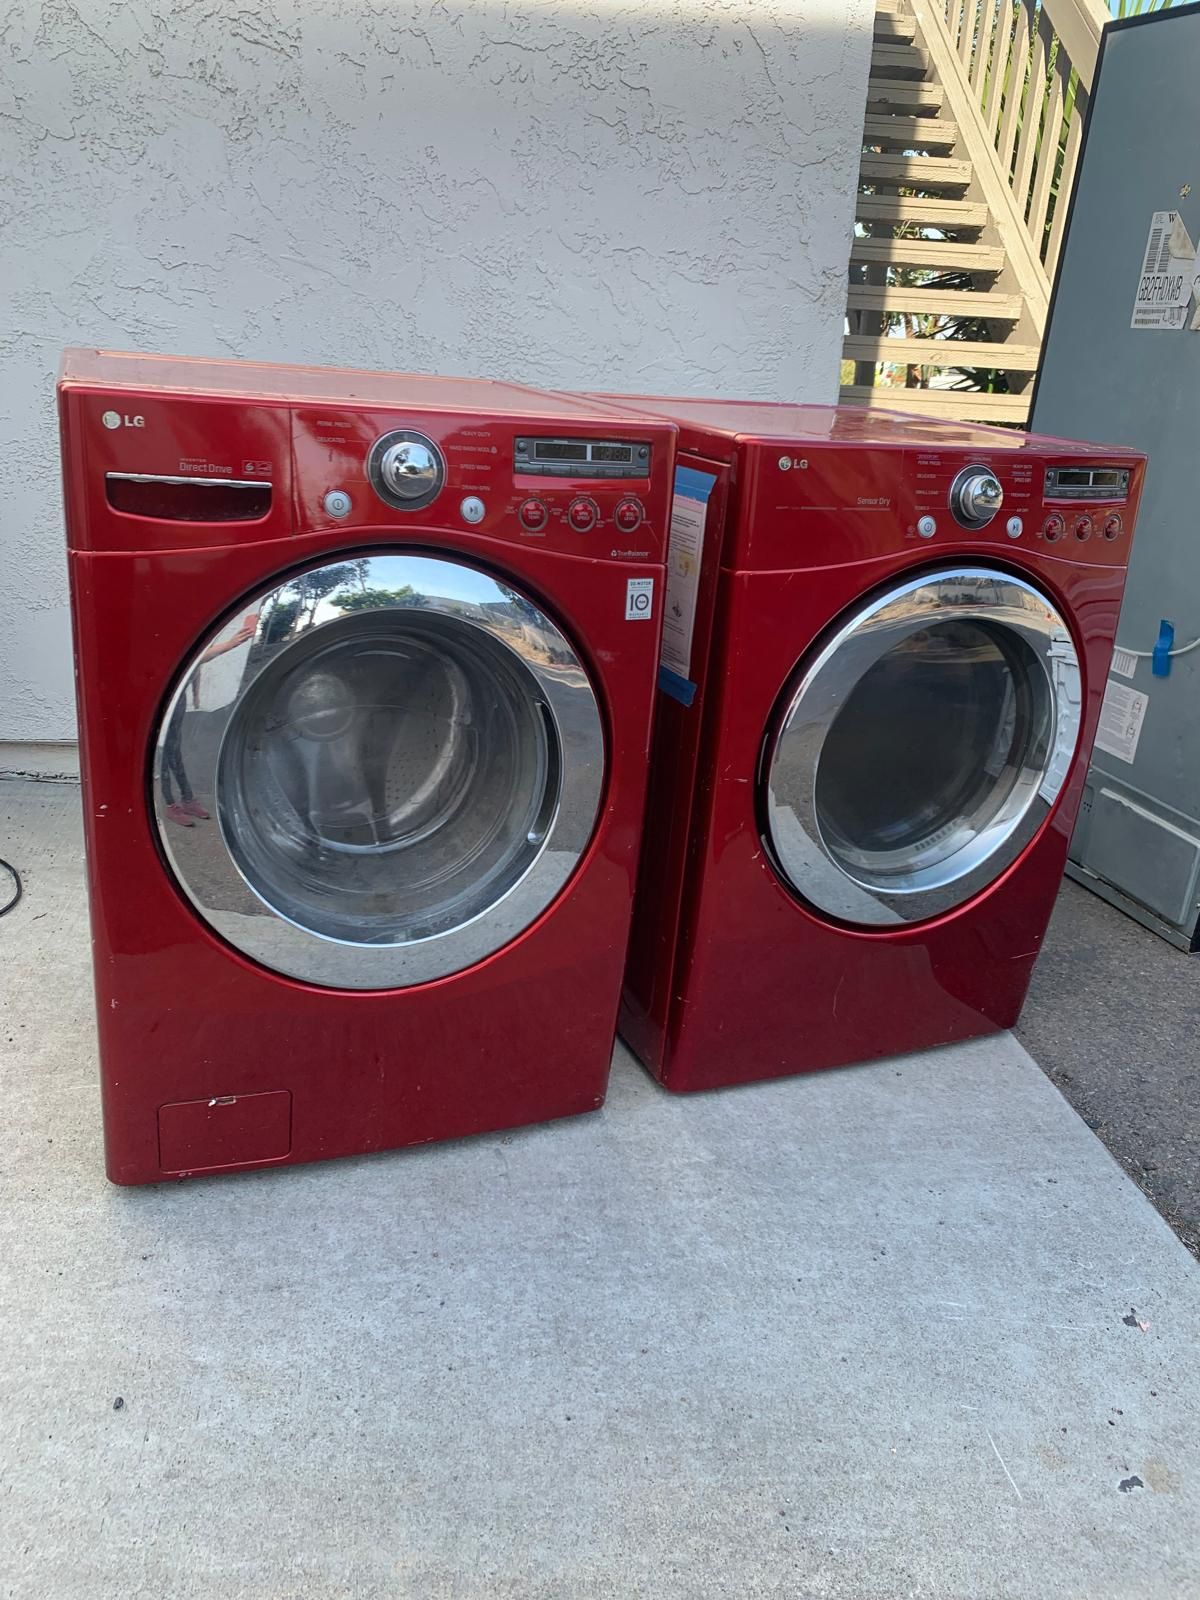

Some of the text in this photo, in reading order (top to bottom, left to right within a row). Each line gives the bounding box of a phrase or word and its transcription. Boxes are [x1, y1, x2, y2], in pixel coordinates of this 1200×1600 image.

[124, 414, 145, 428] LG
[179, 462, 208, 472] Direct
[208, 463, 233, 474] Drive
[793, 458, 808, 469] LG
[857, 497, 891, 507] Sensor Dry
[629, 593, 650, 612] 10
